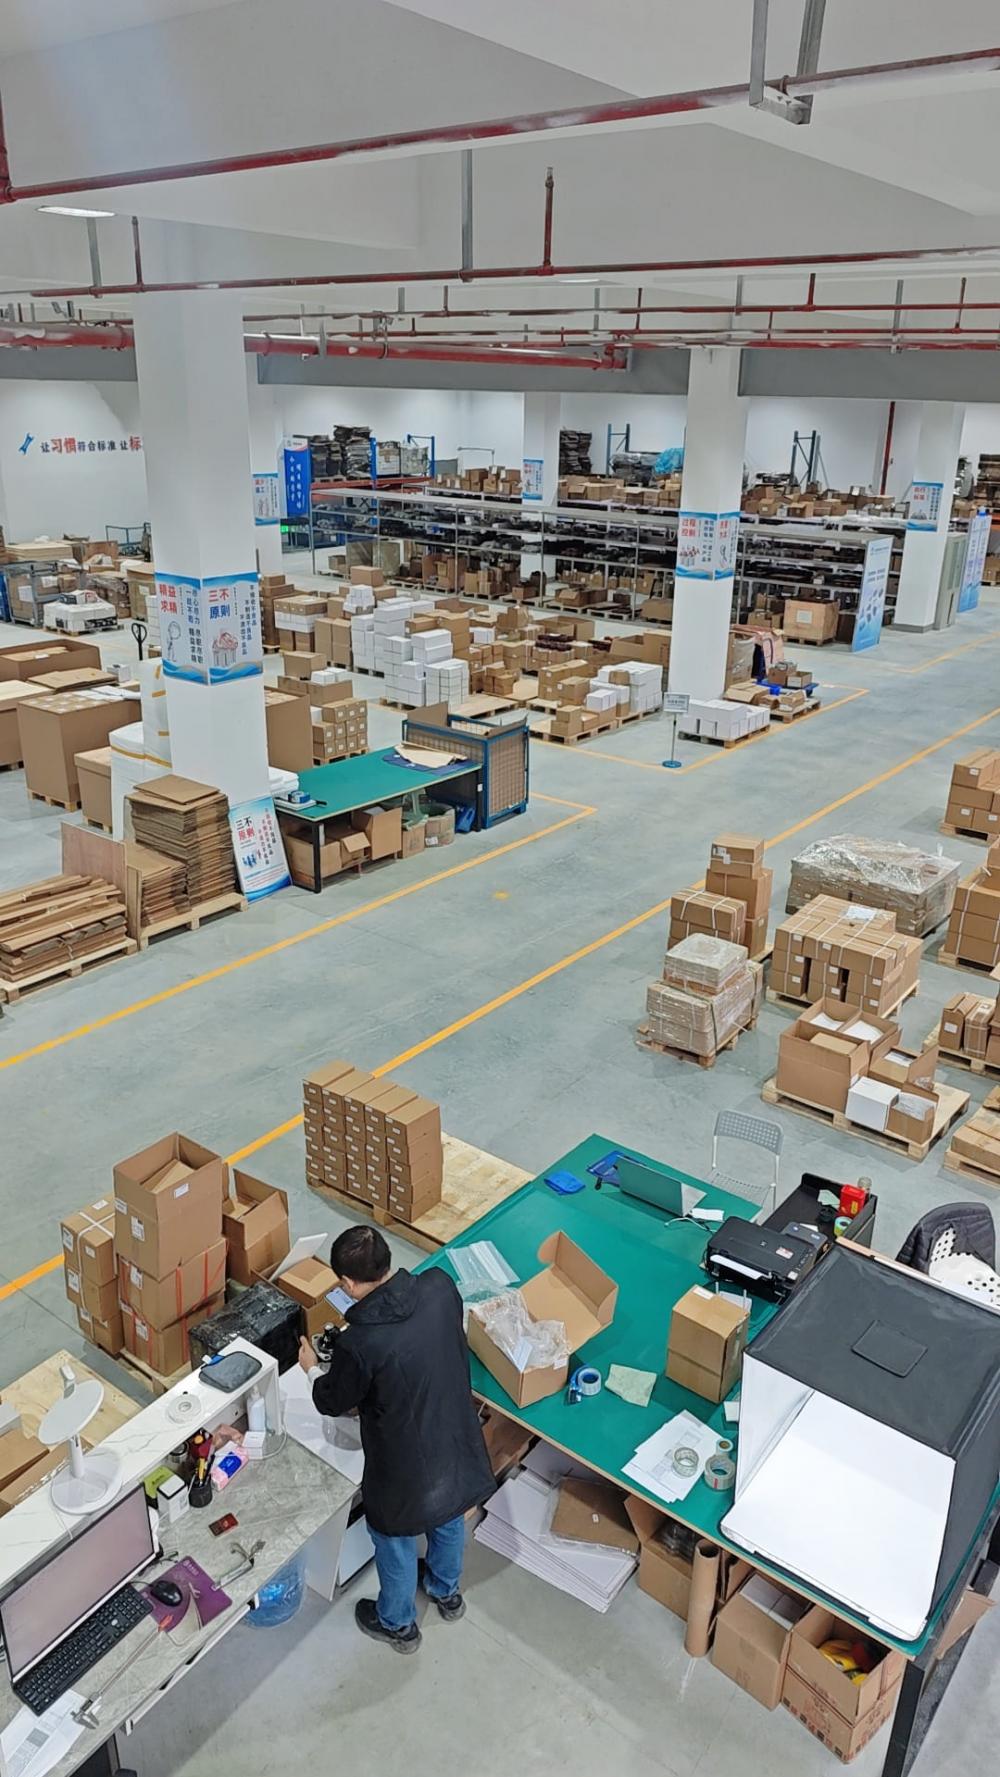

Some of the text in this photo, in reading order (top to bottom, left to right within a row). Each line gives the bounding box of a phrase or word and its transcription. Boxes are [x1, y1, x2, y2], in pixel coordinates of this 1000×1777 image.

[208, 588, 230, 602] 三不
[210, 604, 230, 620] 原则
[236, 816, 252, 830] 三不
